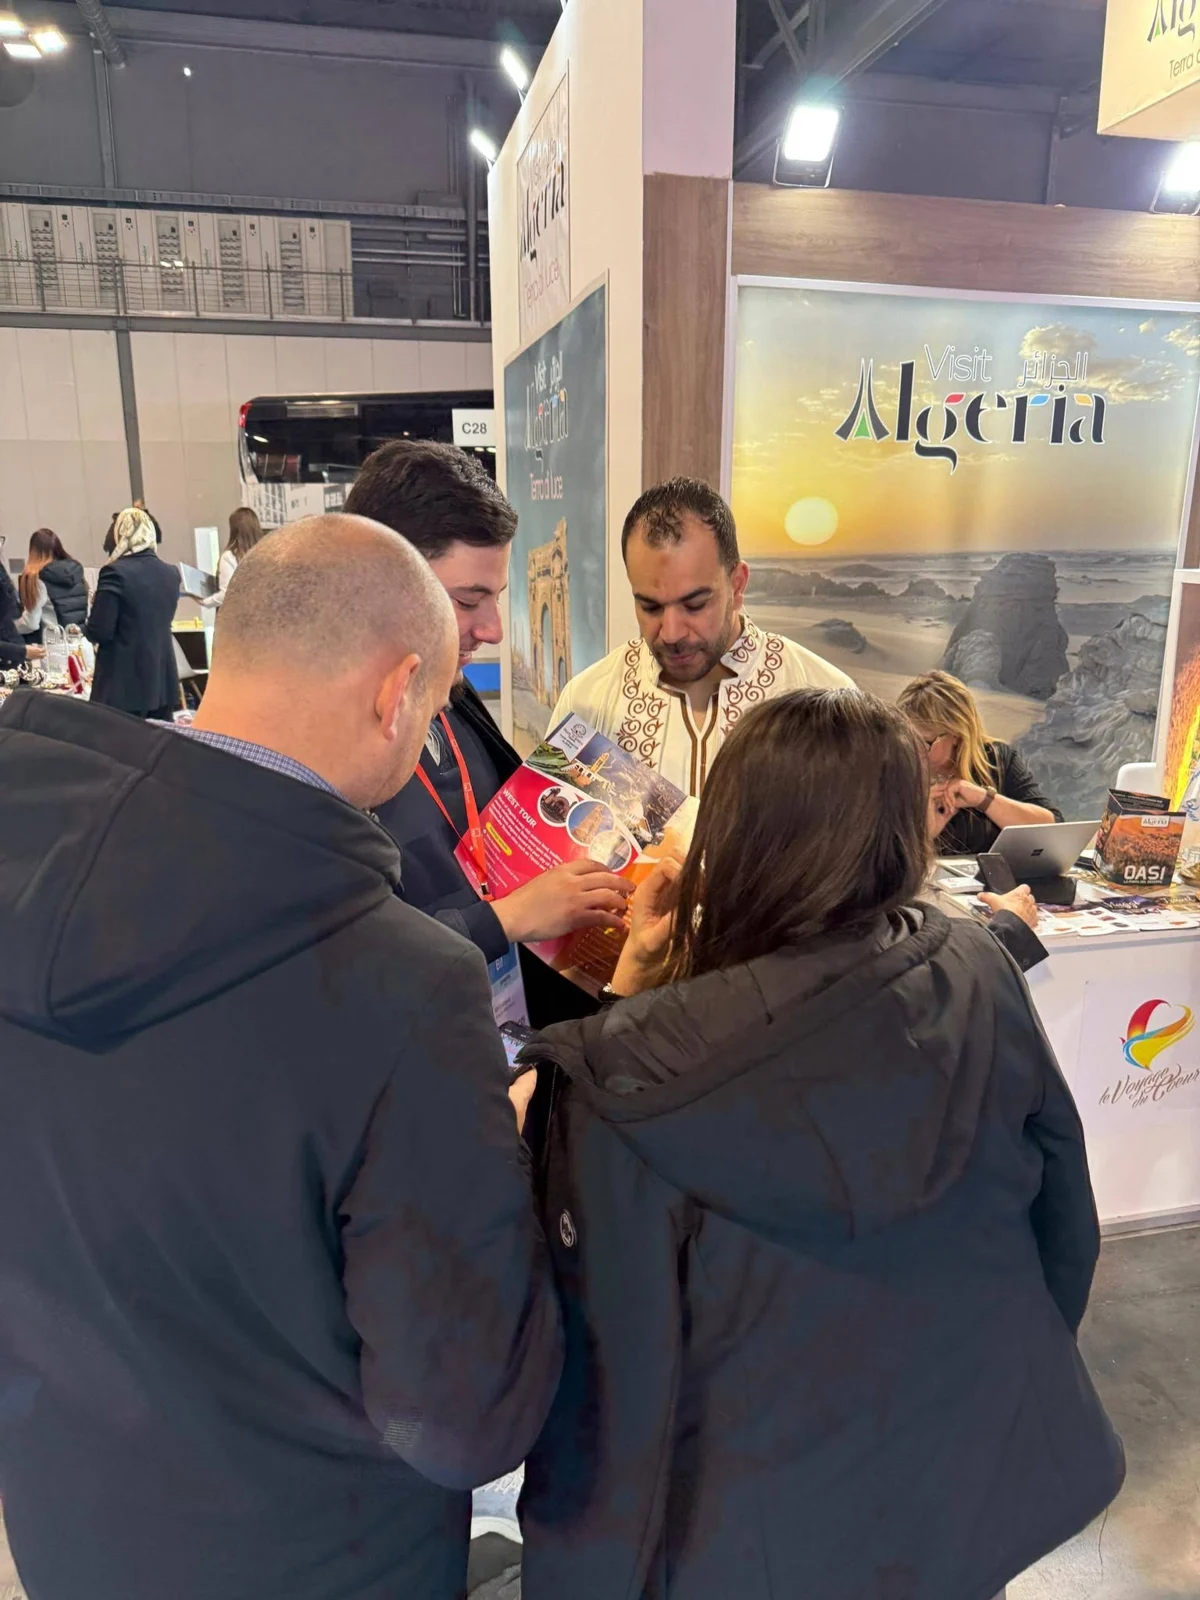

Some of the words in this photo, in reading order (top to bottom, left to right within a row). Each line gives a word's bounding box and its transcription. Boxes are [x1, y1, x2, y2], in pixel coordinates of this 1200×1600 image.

[1169, 52, 1194, 79] Terra
[924, 344, 993, 382] Visit
[1018, 351, 1088, 389] الجزائر
[462, 422, 487, 435] C28
[834, 357, 1106, 475] Algeria
[503, 788, 519, 808] WEST
[519, 808, 536, 828] TOUR
[1124, 865, 1166, 880] OASI
[1111, 1067, 1170, 1104] Voyage
